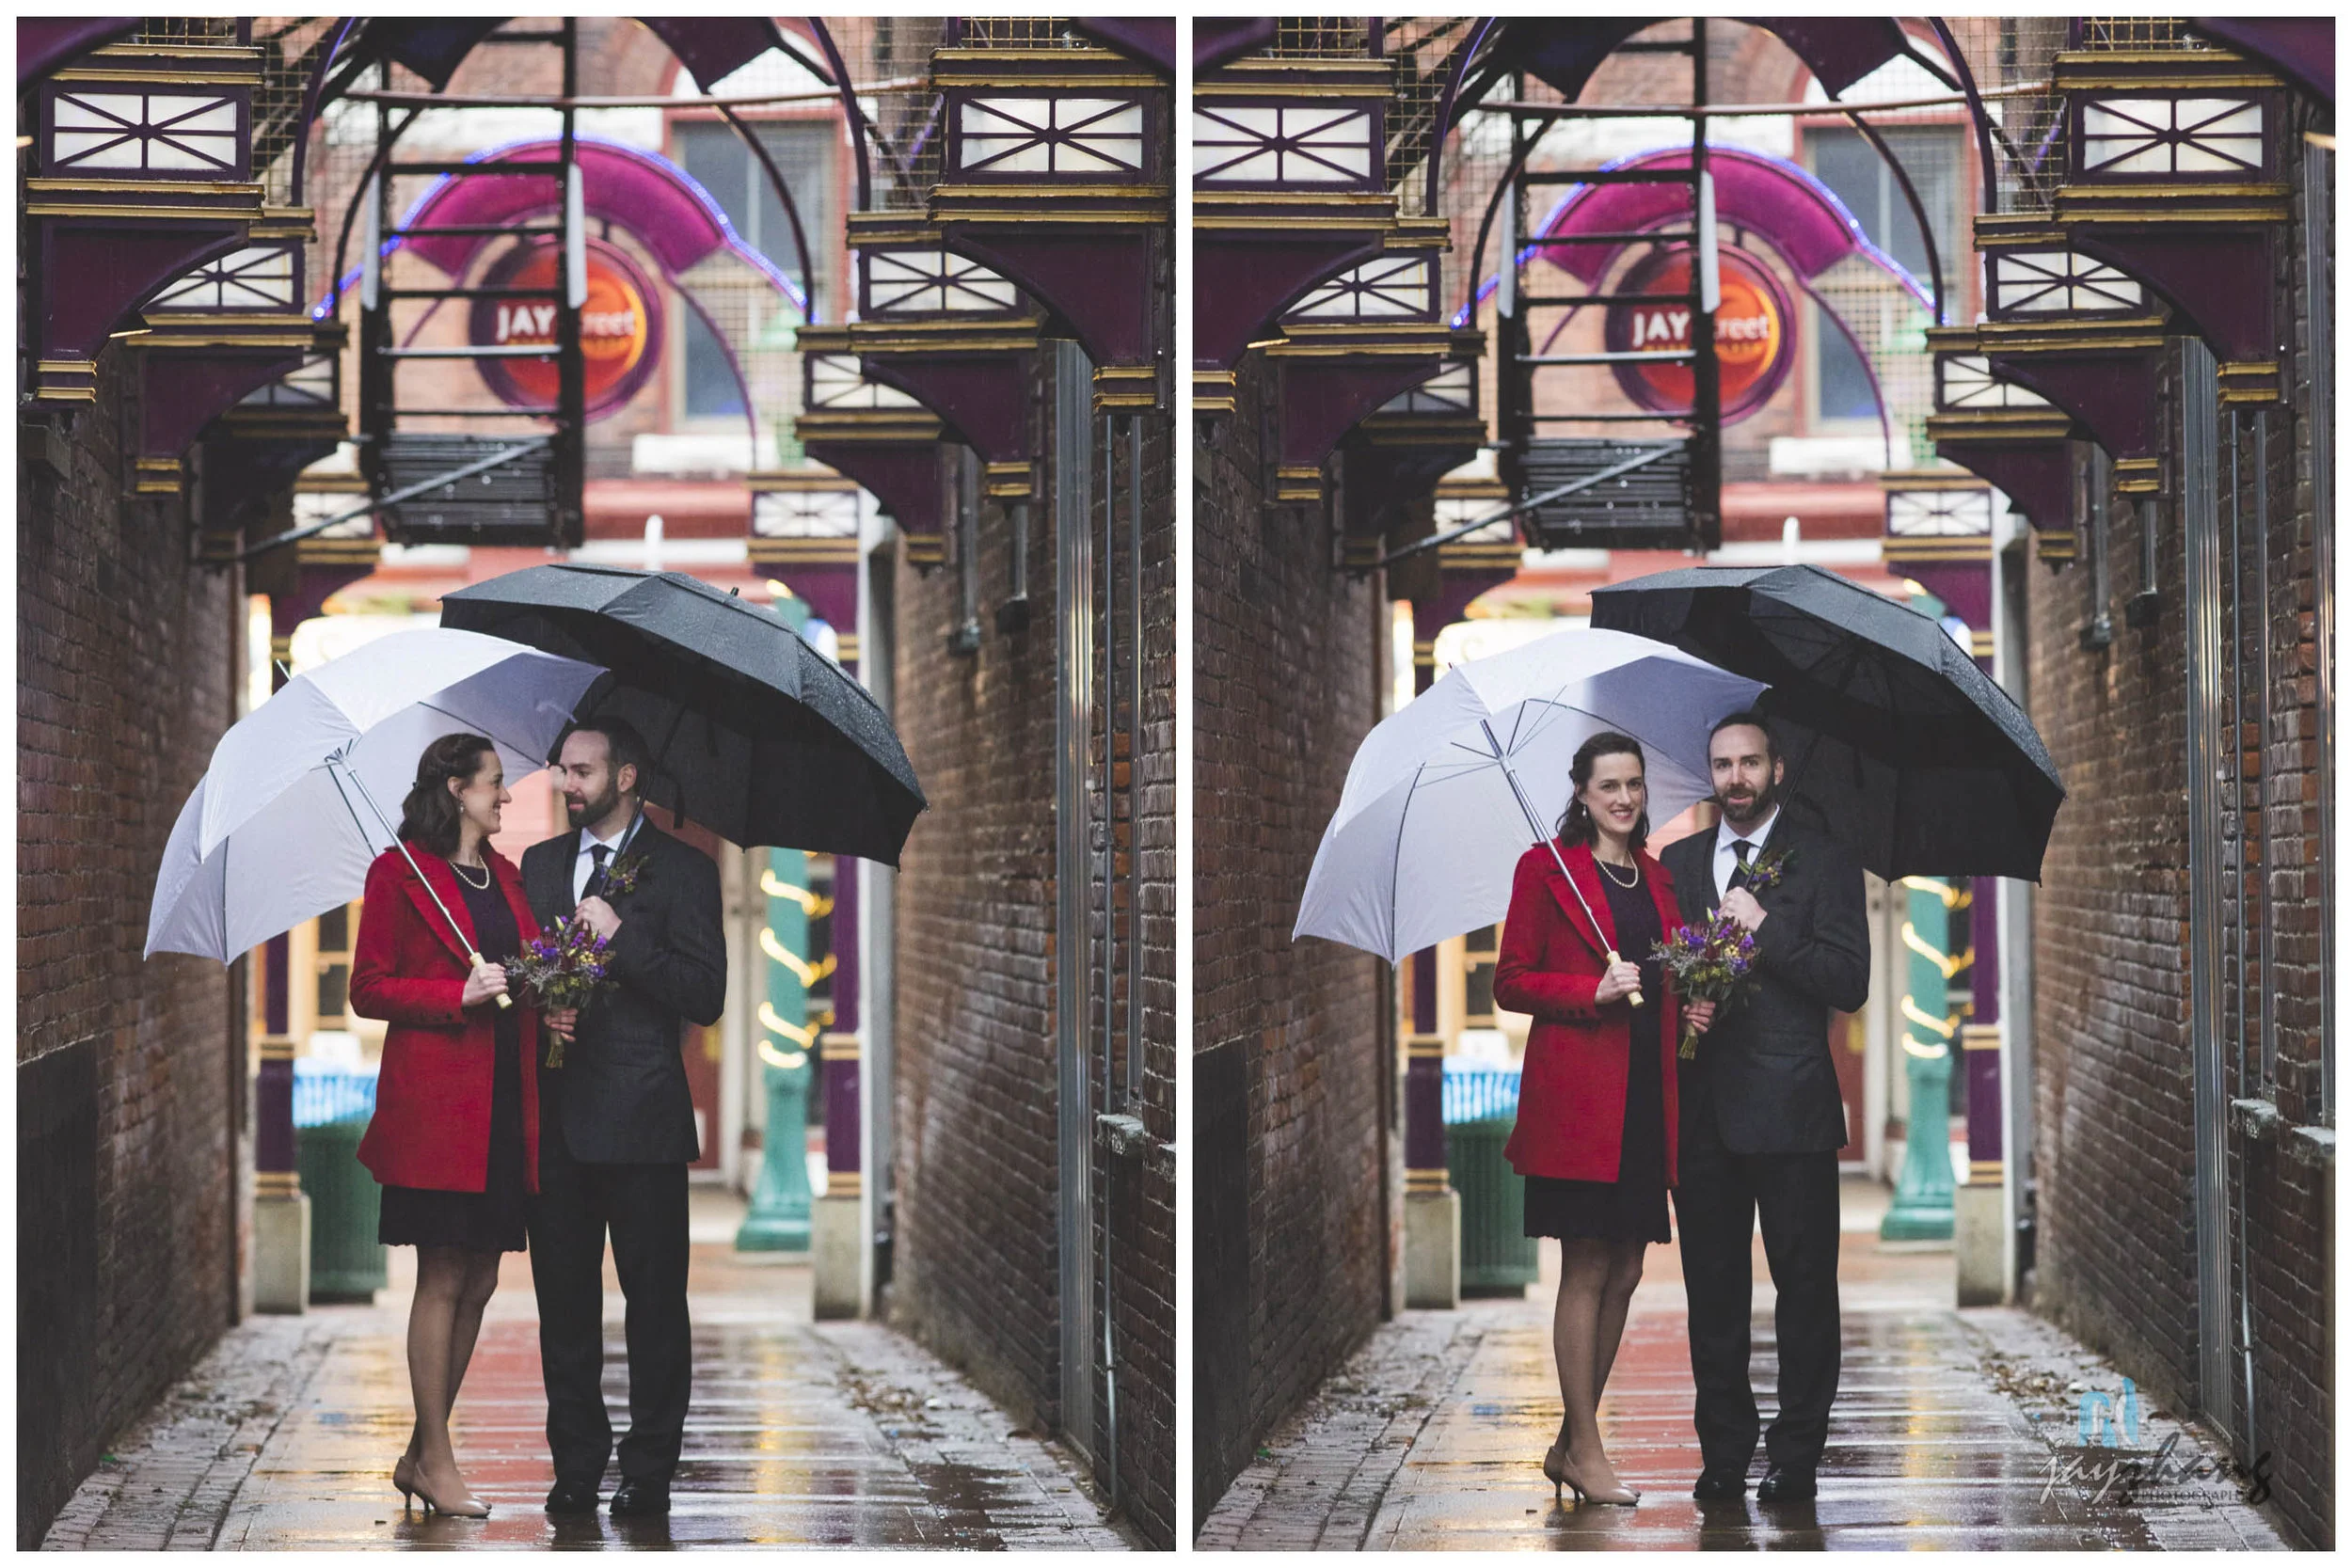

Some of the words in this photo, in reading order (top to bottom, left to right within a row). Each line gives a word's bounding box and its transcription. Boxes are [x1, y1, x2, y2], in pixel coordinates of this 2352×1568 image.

[496, 305, 557, 342] JAY
[1632, 311, 1691, 348] JAY
[1714, 315, 1770, 340] reet
